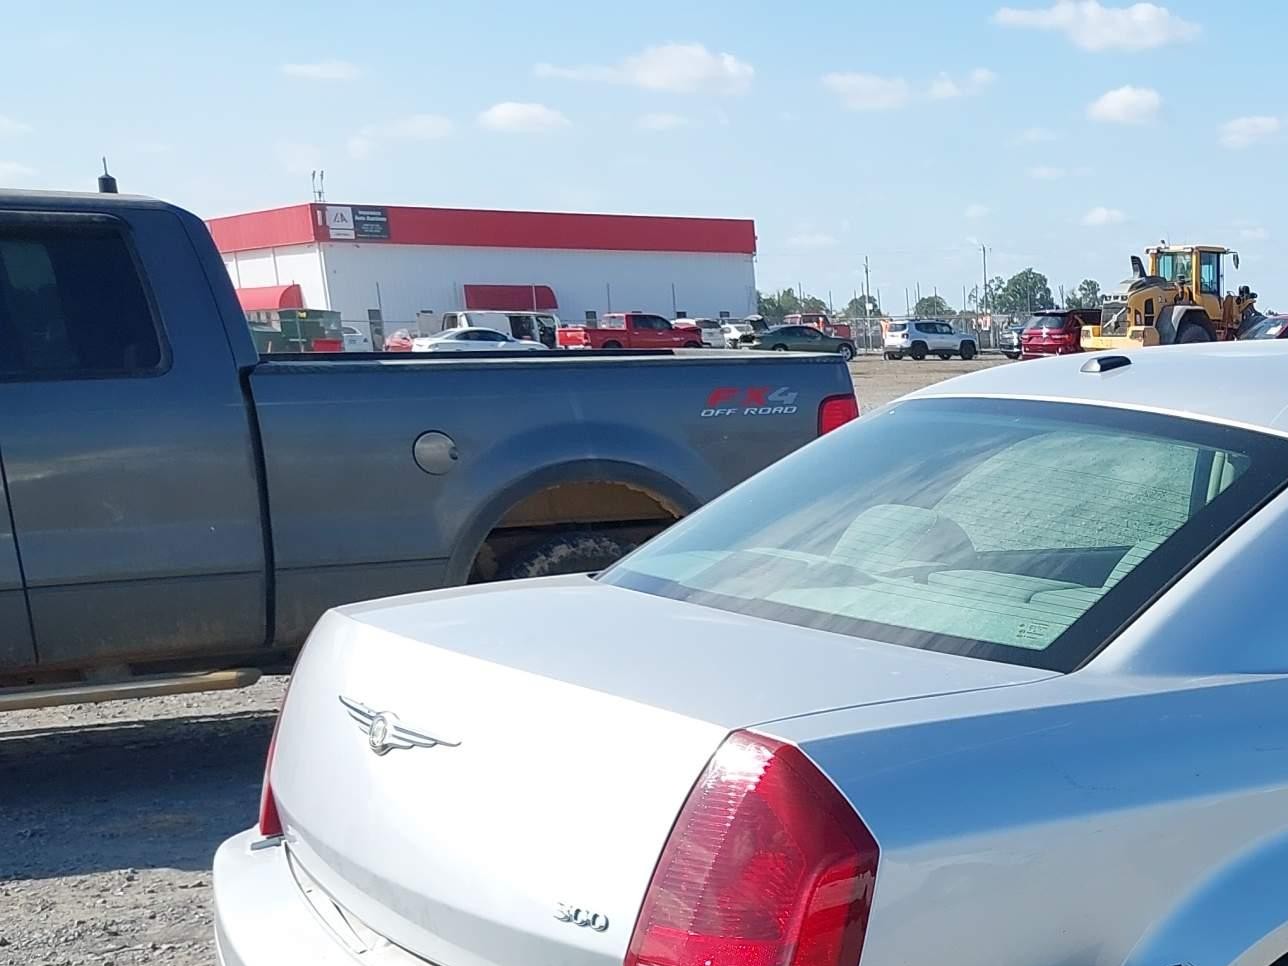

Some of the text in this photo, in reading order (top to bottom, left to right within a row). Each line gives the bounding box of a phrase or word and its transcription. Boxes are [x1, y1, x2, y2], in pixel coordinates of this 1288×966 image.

[706, 386, 799, 407] FX4
[701, 406, 798, 417] OFF ROAD
[552, 900, 610, 932] 300
